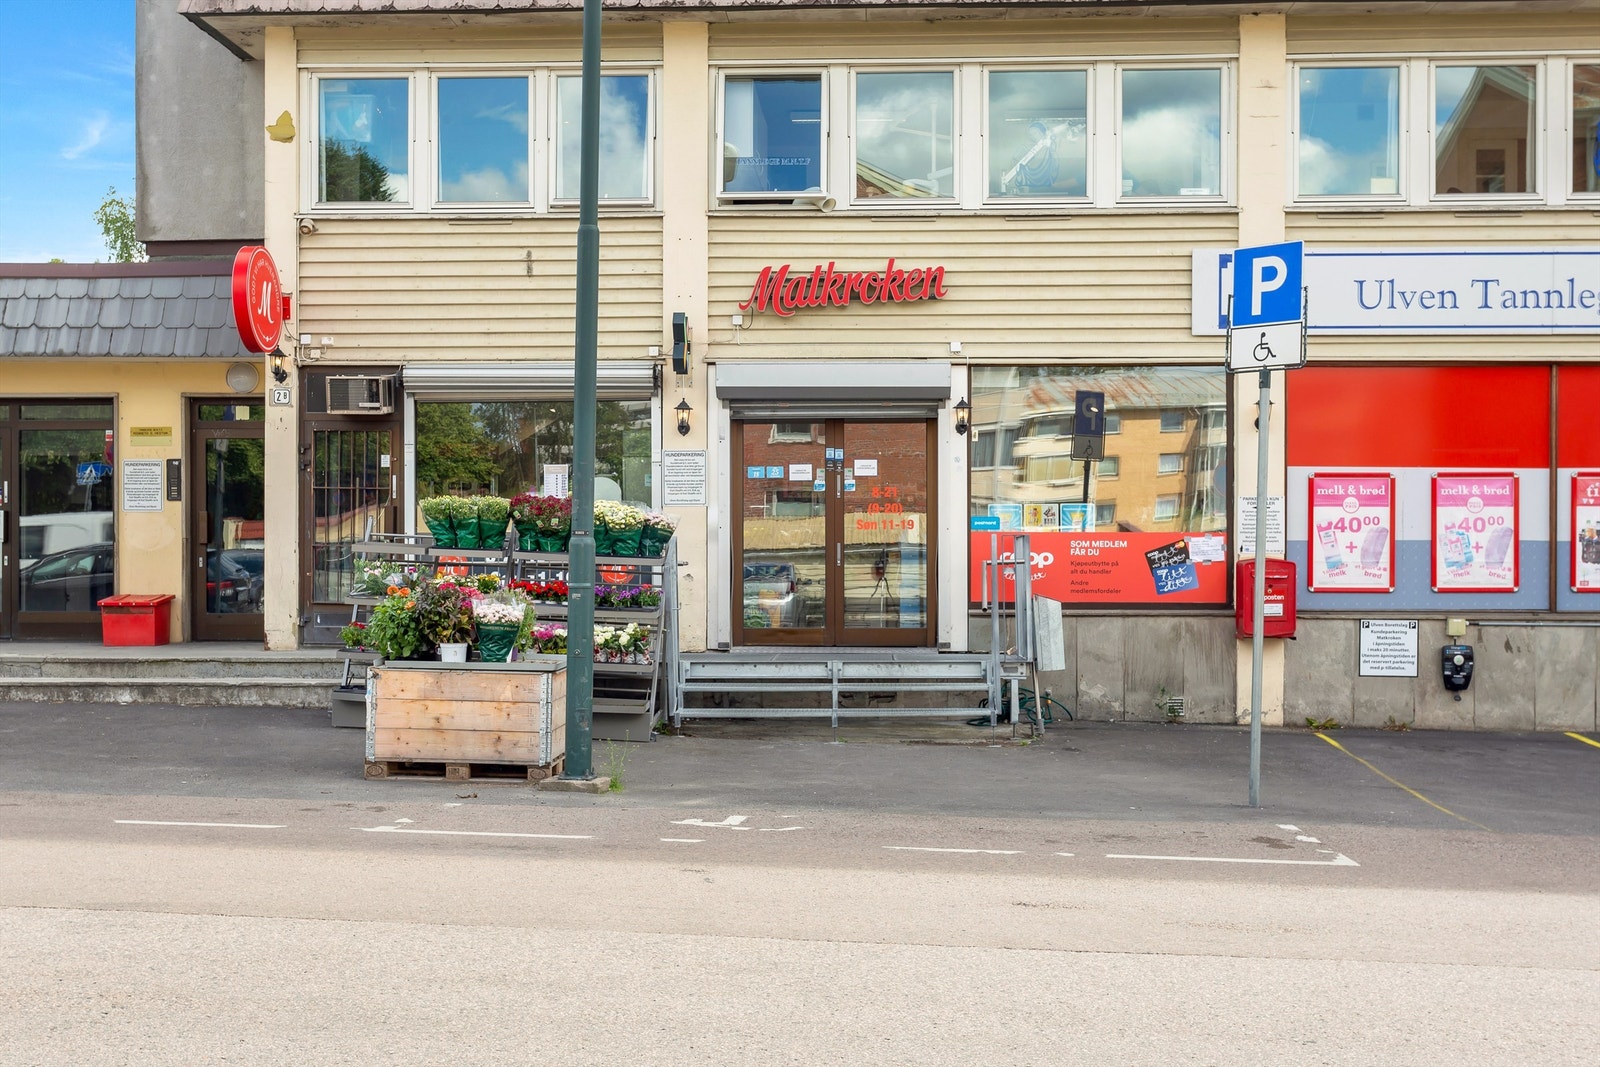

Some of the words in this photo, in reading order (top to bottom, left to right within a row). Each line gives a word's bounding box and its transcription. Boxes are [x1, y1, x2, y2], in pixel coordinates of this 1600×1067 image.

[738, 257, 949, 317] Matkroken
[1251, 255, 1287, 316] P
[257, 280, 274, 324] M
[1353, 278, 1459, 310] Ulven
[1471, 277, 1600, 317] Tannle
[871, 487, 898, 498] 8-21
[1317, 485, 1345, 495] melk
[1348, 485, 1356, 495] &
[1360, 485, 1386, 495] brød
[1441, 485, 1470, 495] melk
[1472, 485, 1481, 495] &
[1484, 485, 1510, 495] brød
[867, 502, 903, 516] (9-20)
[856, 519, 878, 530] Søn
[881, 519, 914, 530] 11-19
[974, 519, 997, 527] postnord
[1070, 540, 1090, 548] SOM
[1092, 540, 1128, 548] MEDLEM
[1070, 547, 1086, 556] FÅR
[1088, 548, 1100, 556] DU
[1070, 560, 1110, 568] Kjøpeutbytte
[1329, 570, 1347, 578] melk
